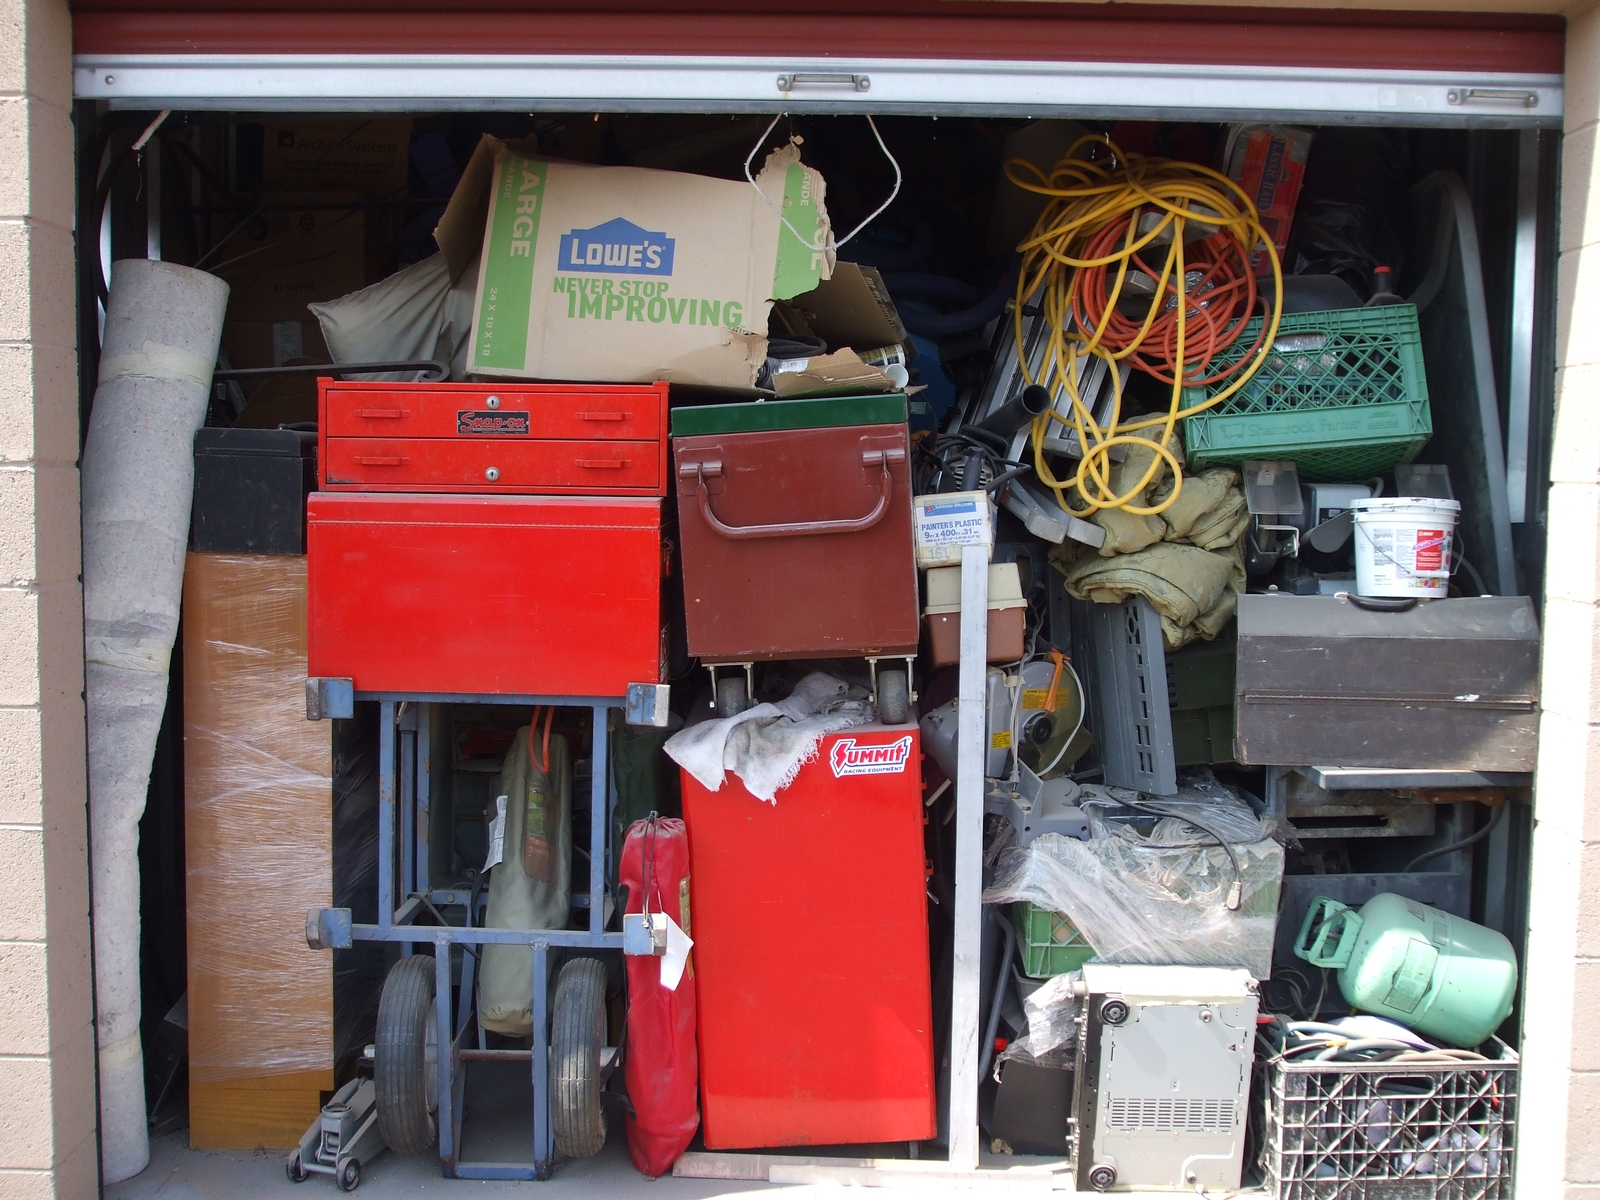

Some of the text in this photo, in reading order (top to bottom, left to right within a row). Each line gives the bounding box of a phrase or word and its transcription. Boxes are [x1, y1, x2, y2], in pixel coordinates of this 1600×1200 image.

[346, 139, 399, 154] Systems
[570, 238, 664, 269] LOWE'S
[489, 287, 498, 301] 24
[553, 276, 670, 298] NEVER STOP
[567, 291, 744, 328] IMPROVING
[485, 316, 494, 328] 18
[482, 343, 491, 356] 18
[460, 412, 526, 432] Snap-on
[1248, 421, 1316, 437] Shamrock
[1317, 418, 1361, 432] Farms
[954, 518, 982, 528] PLASTIC
